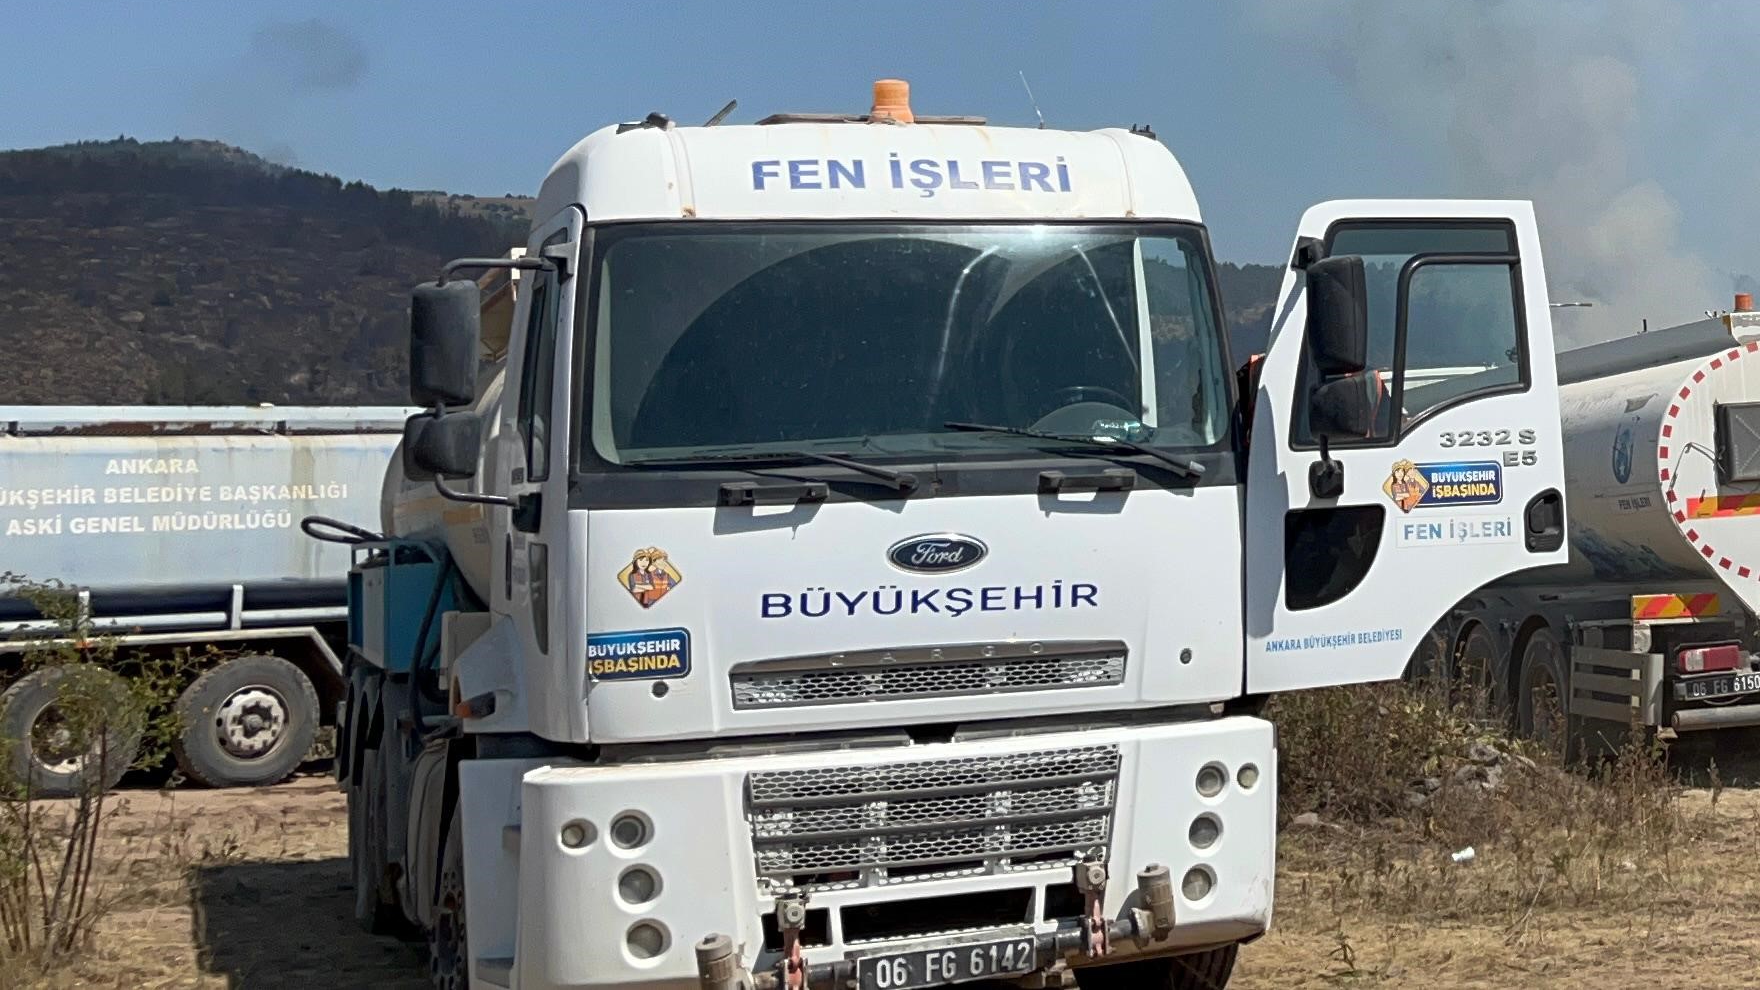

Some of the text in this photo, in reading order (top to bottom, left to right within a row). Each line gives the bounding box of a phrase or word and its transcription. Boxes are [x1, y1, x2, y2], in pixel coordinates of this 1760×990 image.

[752, 152, 1072, 198] FEN İŞLERİ
[1440, 428, 1536, 448] 3232 S
[105, 458, 199, 475] ANKARA
[1502, 450, 1538, 467] E5
[104, 483, 212, 504] BELEDİYE
[219, 481, 348, 505] BAŞKANLIĞI
[1432, 483, 1497, 499] İŞBAŞINDA
[6, 510, 292, 536] ASKİ GENEL MÜDÜRLÜĞÜ
[1404, 517, 1512, 542] FEN İŞLERİ
[911, 542, 964, 564] Ford
[761, 579, 1099, 618] BÜYÜKŞEHİR
[829, 642, 1043, 666] CARGO
[1265, 639, 1302, 652] ANKARA
[1304, 633, 1355, 649] BÜYÜKŞEHİR
[1692, 674, 1760, 696] 06 FG 6150
[876, 942, 1030, 988] 06 FG 6142
